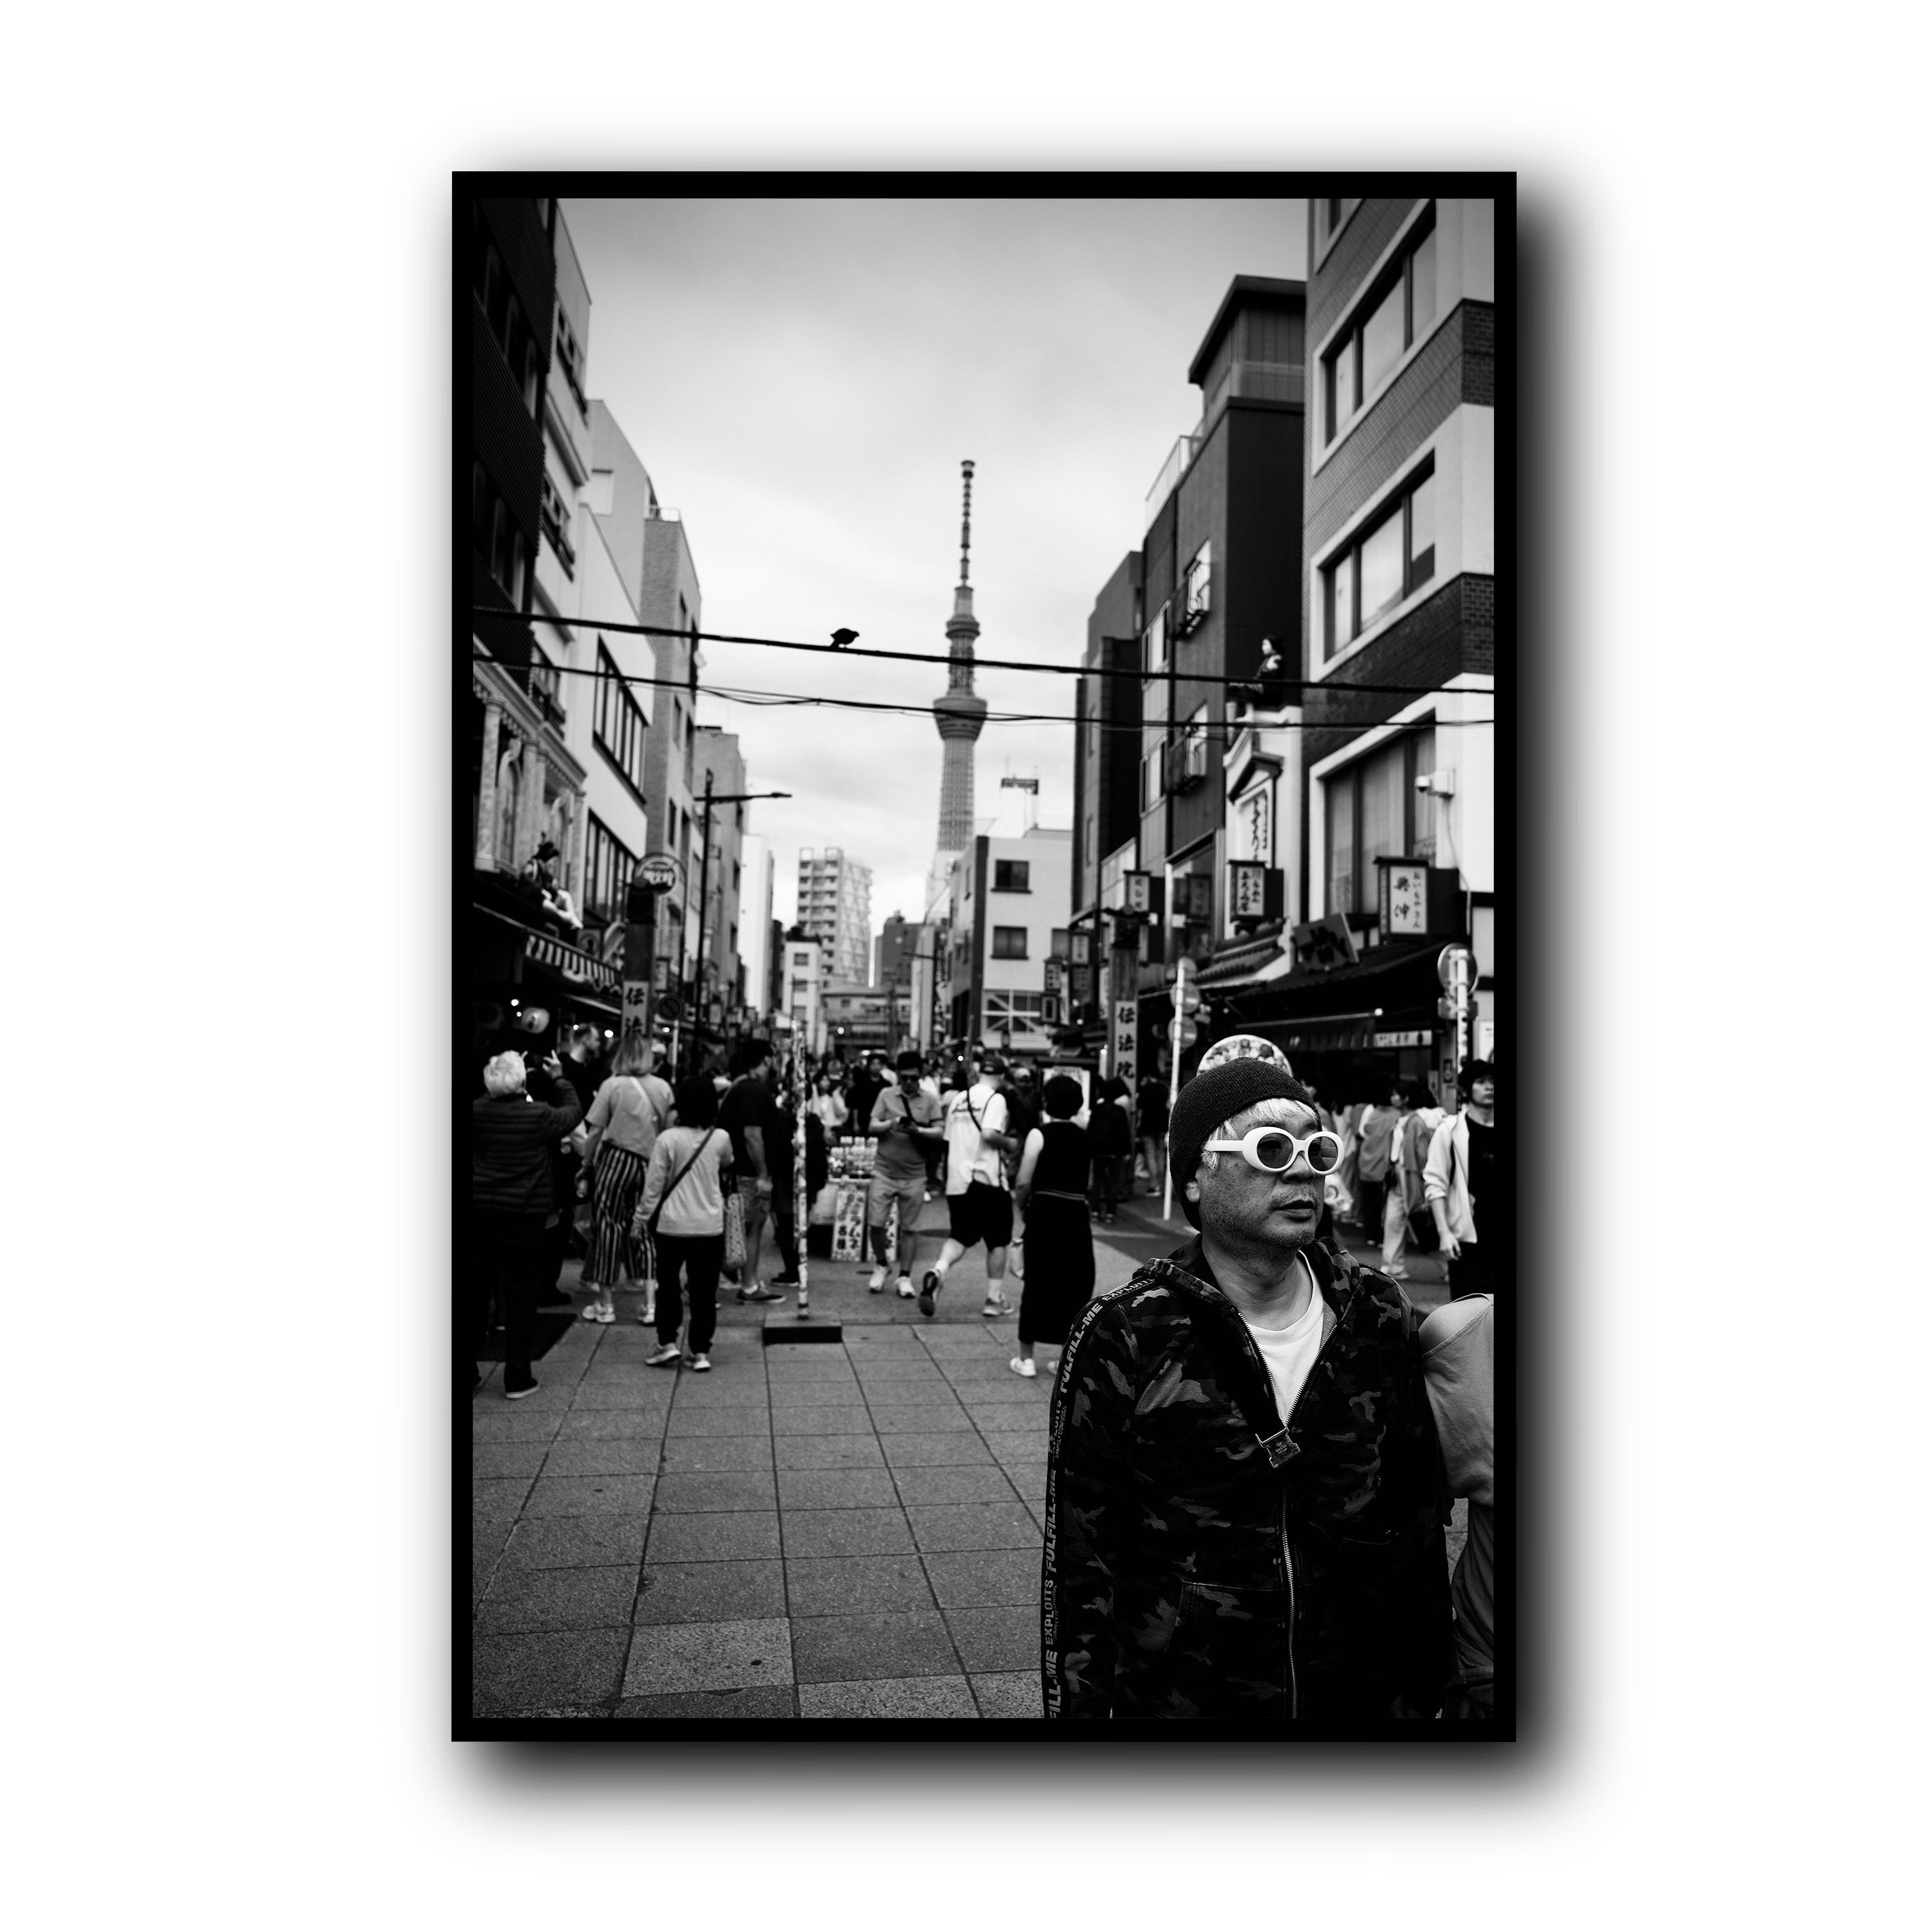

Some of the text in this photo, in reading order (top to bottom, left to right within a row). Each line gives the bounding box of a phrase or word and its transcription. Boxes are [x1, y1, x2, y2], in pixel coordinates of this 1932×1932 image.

[1059, 1302, 1103, 1394] FULFILL-ME
[1046, 1468, 1057, 1573] FULFILL-ME
[1044, 1579, 1054, 1645] EXPLOITS
